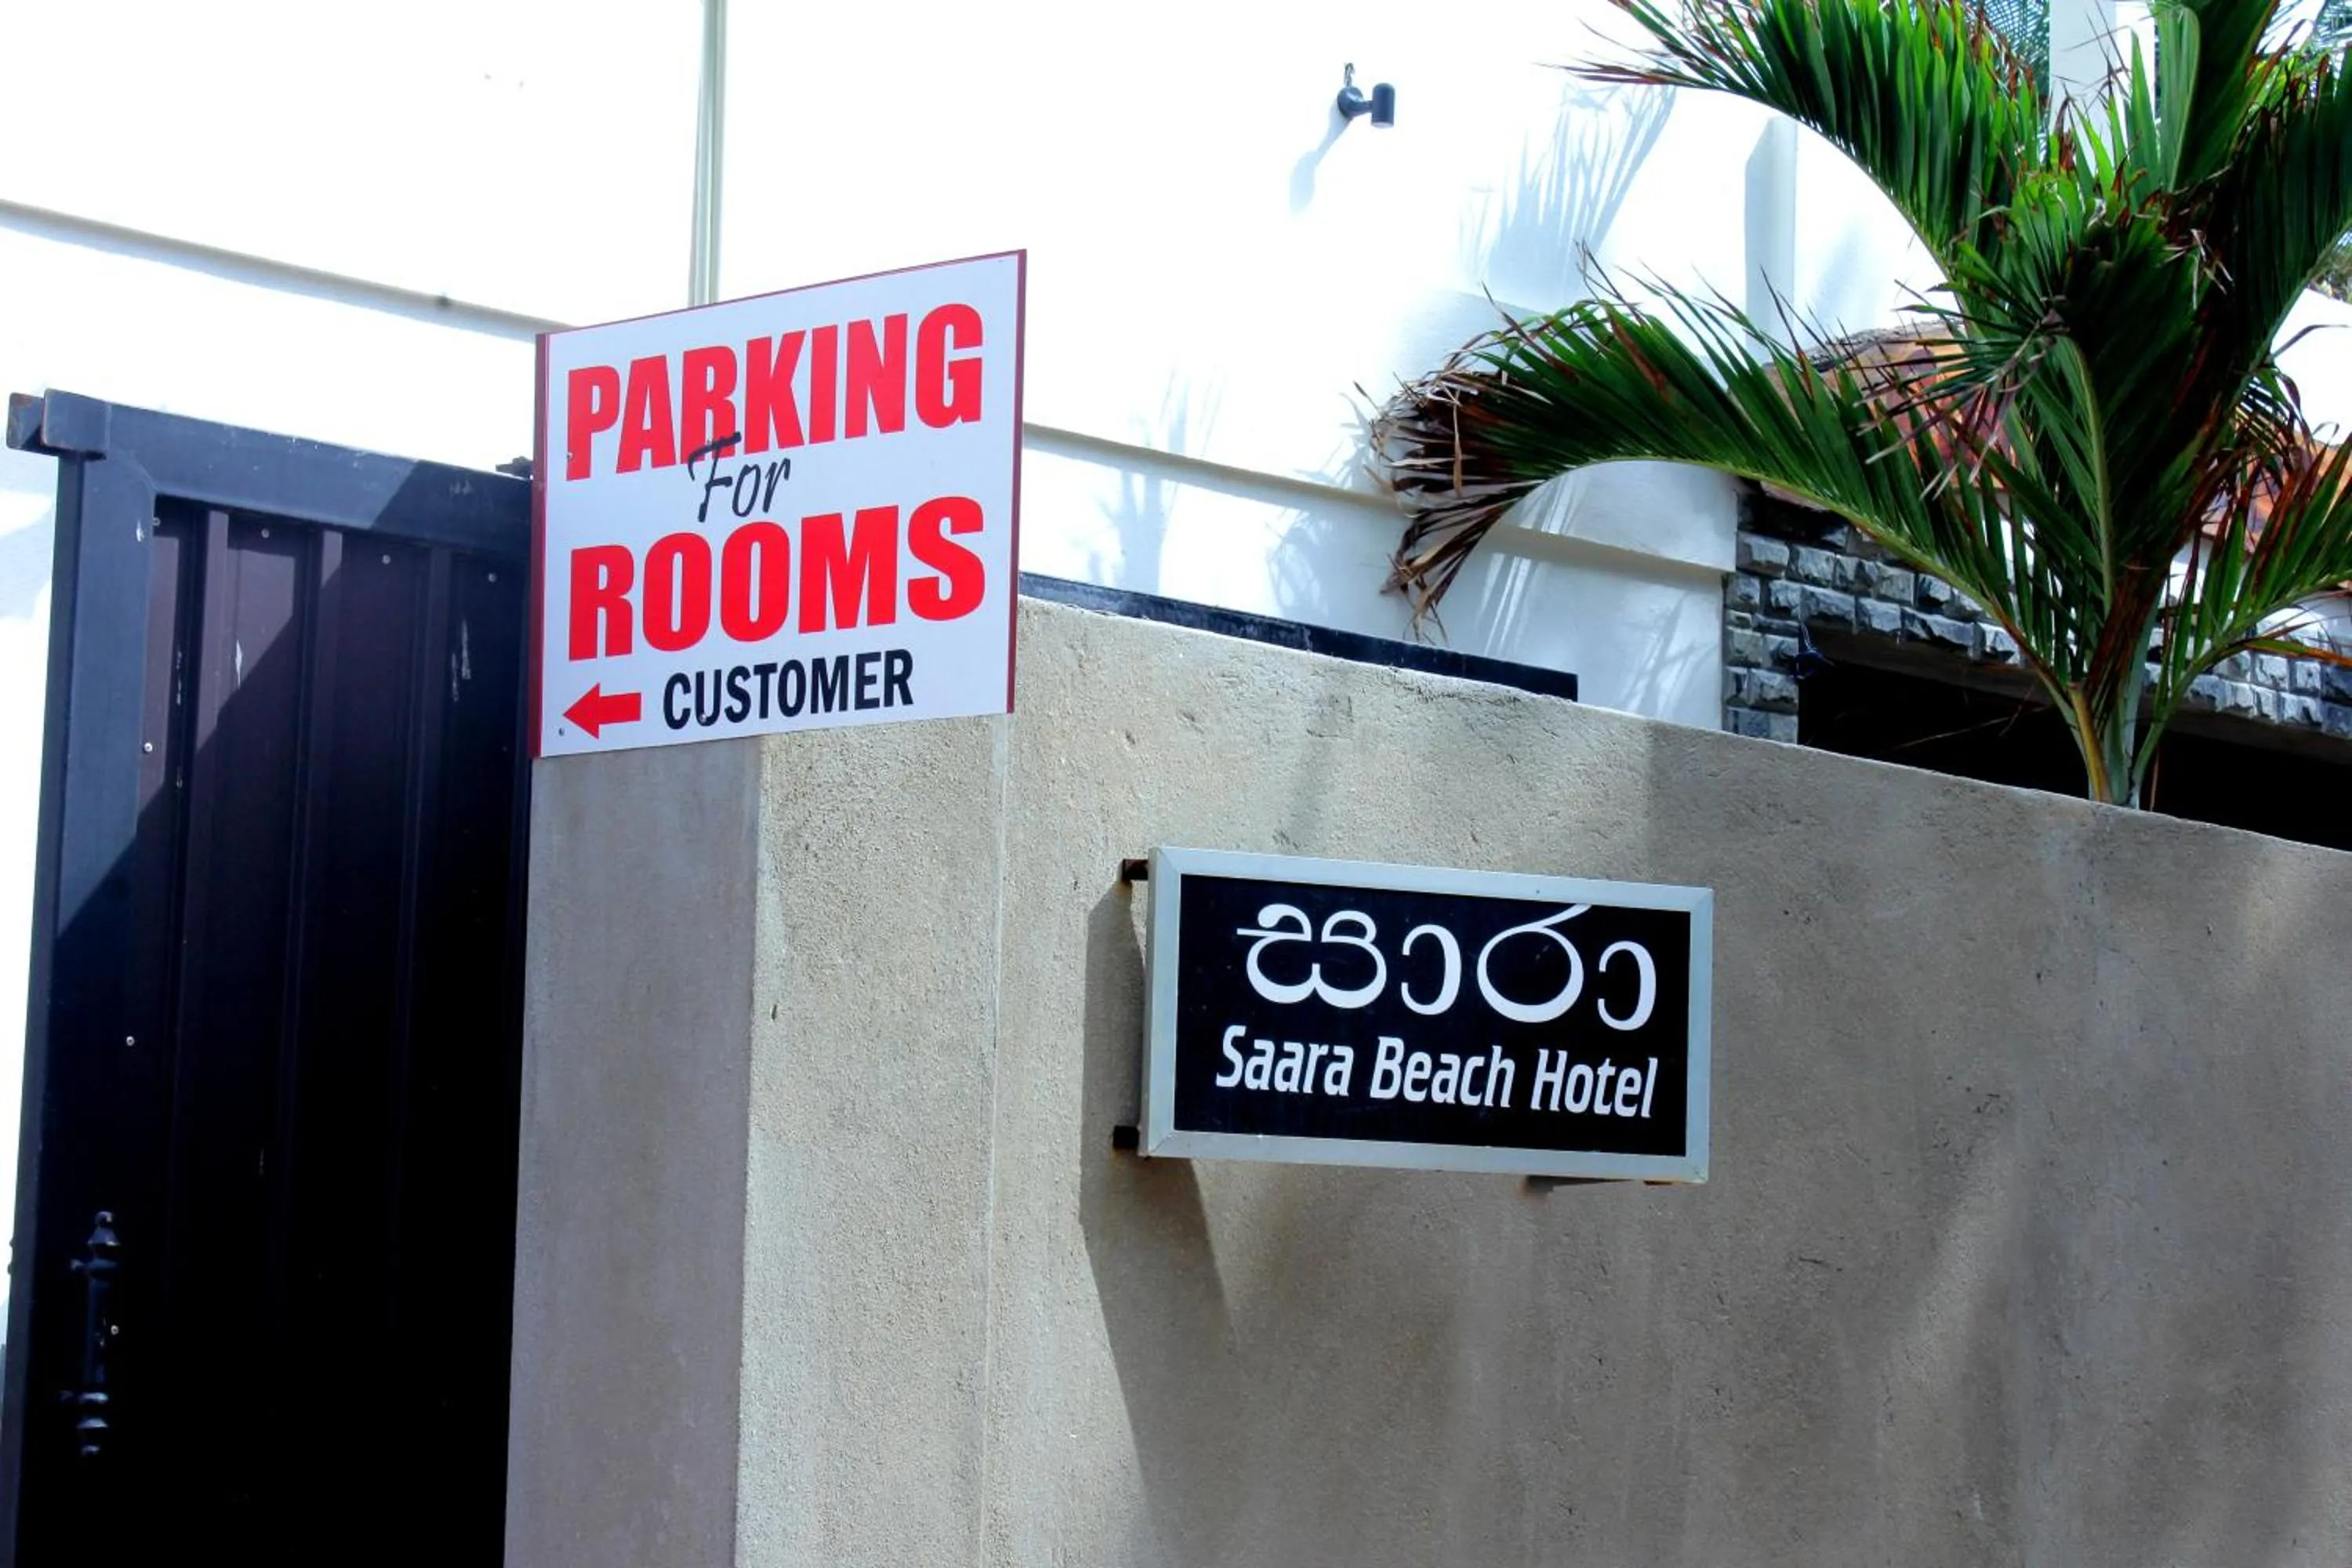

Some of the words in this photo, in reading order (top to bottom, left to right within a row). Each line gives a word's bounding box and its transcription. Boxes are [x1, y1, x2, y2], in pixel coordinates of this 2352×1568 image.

[566, 303, 983, 481] PARKING
[688, 432, 791, 523] For
[568, 496, 985, 662] ROOMS
[662, 648, 914, 731] CUSTOMER
[1236, 903, 1656, 1030] සාරා
[1215, 1024, 1355, 1097] Saara
[1370, 1036, 1517, 1109] Beach
[1530, 1048, 1659, 1118] Hotel
